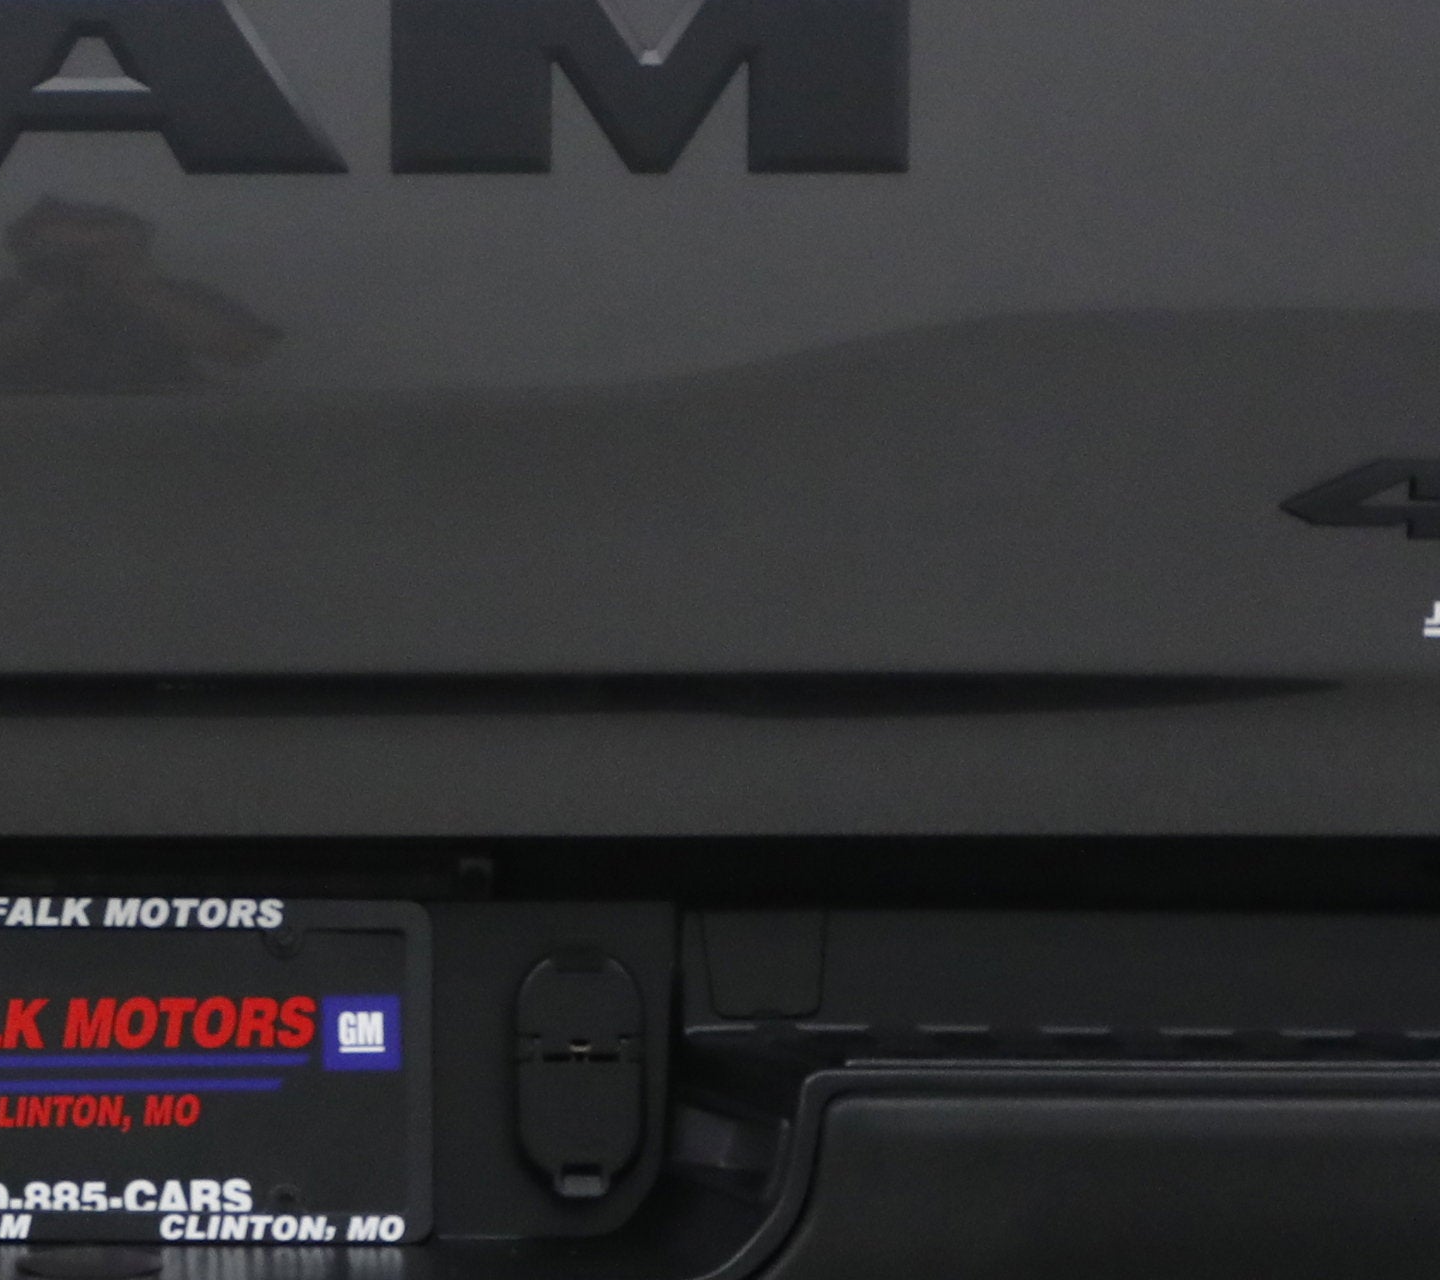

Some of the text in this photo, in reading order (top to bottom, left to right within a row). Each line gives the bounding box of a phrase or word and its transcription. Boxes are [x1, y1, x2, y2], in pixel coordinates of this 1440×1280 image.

[103, 898, 284, 928] MOTORS
[62, 996, 317, 1050] MOTORS
[337, 1010, 386, 1048] GM
[142, 1095, 202, 1128] MO
[158, 1215, 407, 1242] CLINTON, MO
